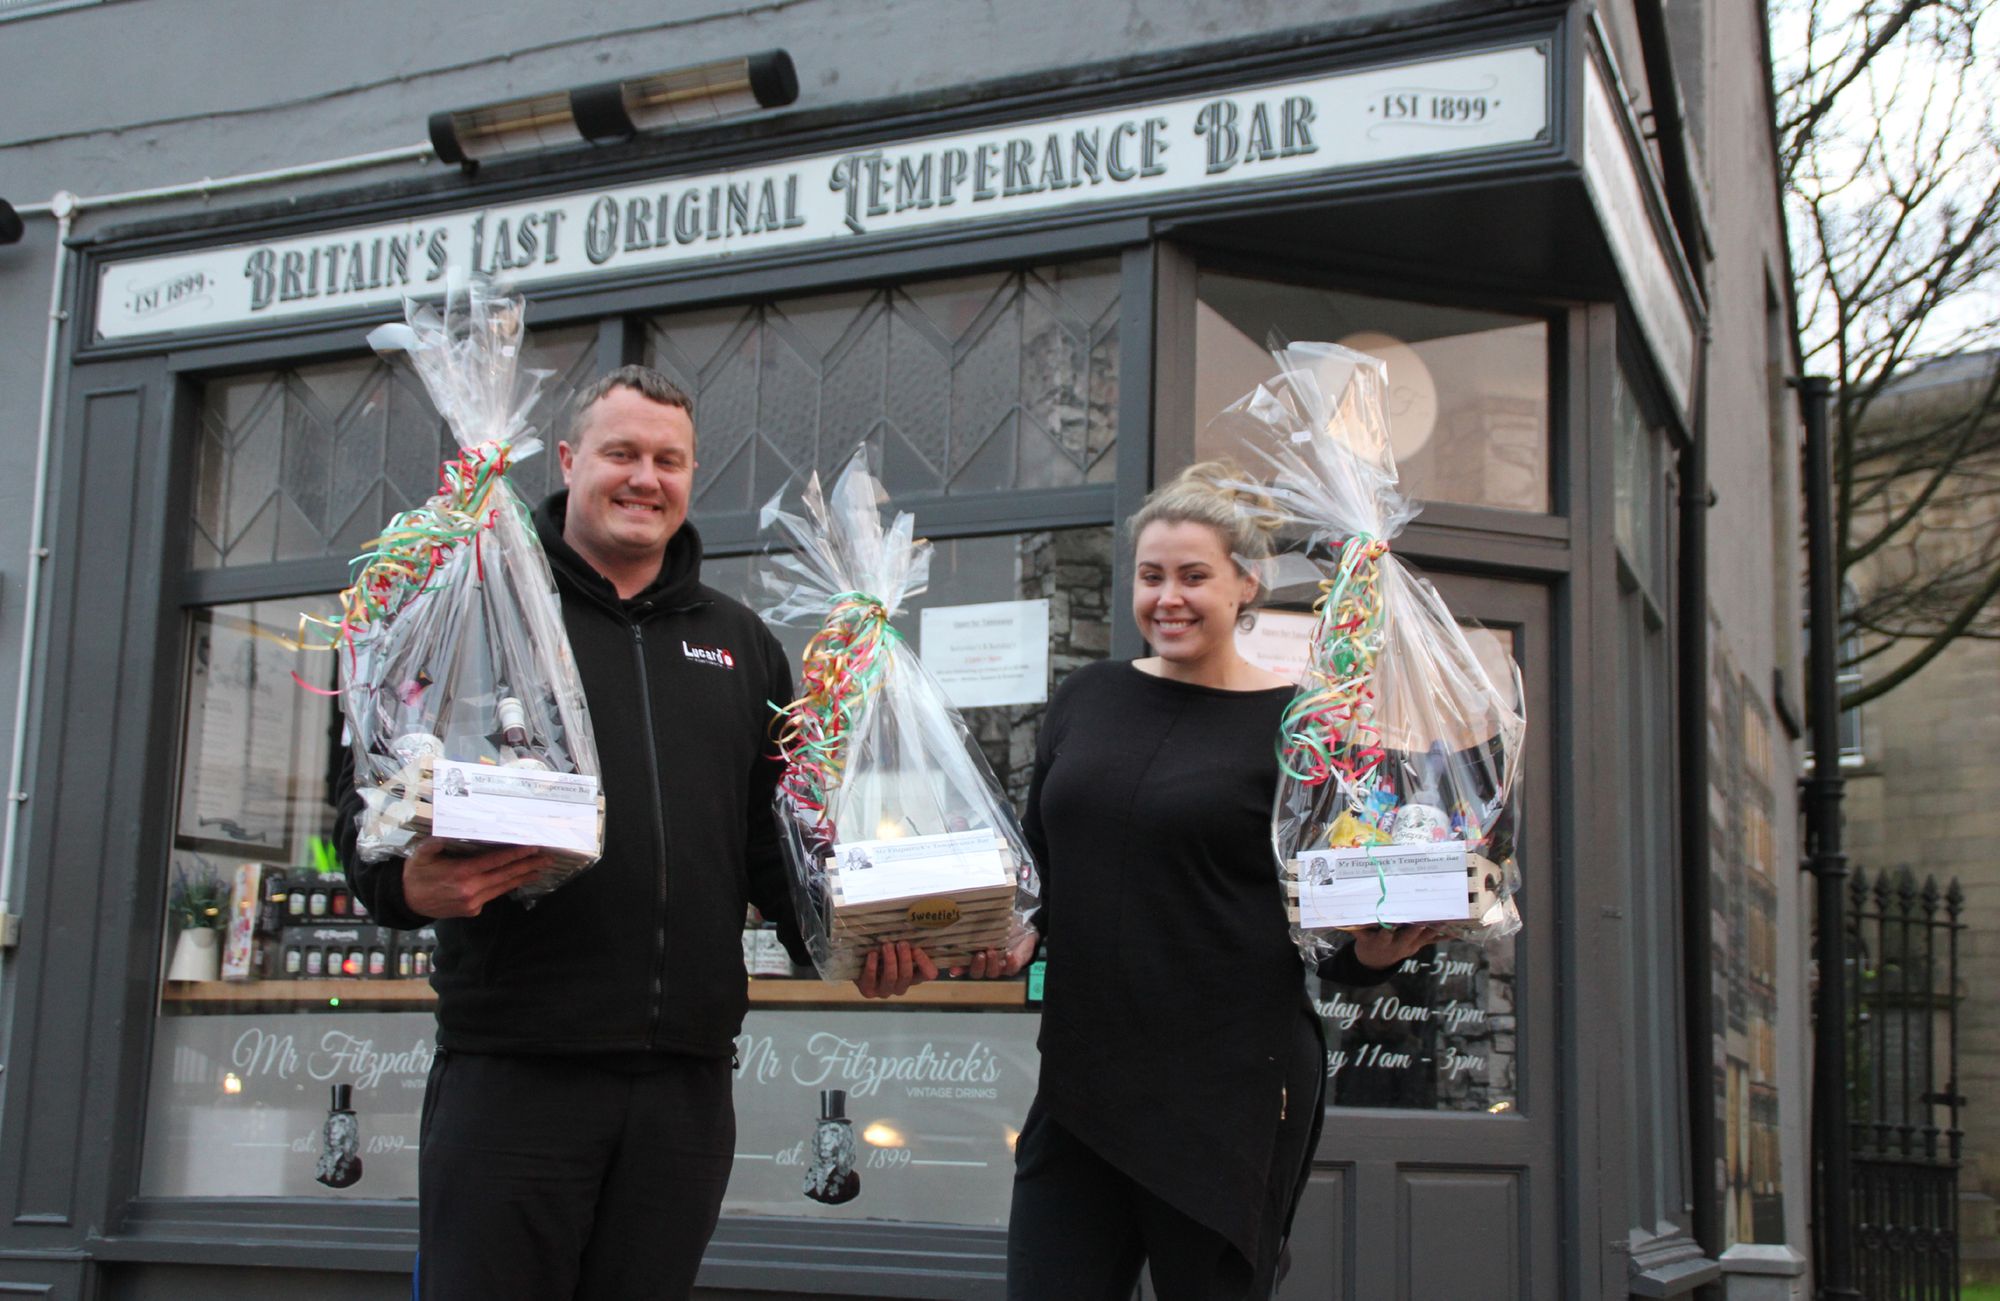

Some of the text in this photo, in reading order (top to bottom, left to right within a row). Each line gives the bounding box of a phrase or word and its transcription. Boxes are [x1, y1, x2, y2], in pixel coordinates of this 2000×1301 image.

[1383, 95, 1488, 122] EST 1899
[244, 94, 1319, 312] BRITAIN'S LAST ORIGINAL TEMPERANCE BAR
[134, 274, 206, 313] EST 1899
[1369, 996, 1488, 1032] 10am-4pm
[232, 1028, 435, 1091] Mr Fitzpatri
[791, 1031, 1002, 1097] Fitzpatrick's
[1354, 1044, 1412, 1069] 11am
[1440, 1047, 1487, 1080] 3pm
[906, 1086, 997, 1099] VINTAGE DRINKS
[366, 1135, 404, 1154] 1899
[776, 1141, 911, 1169] est. 1899
